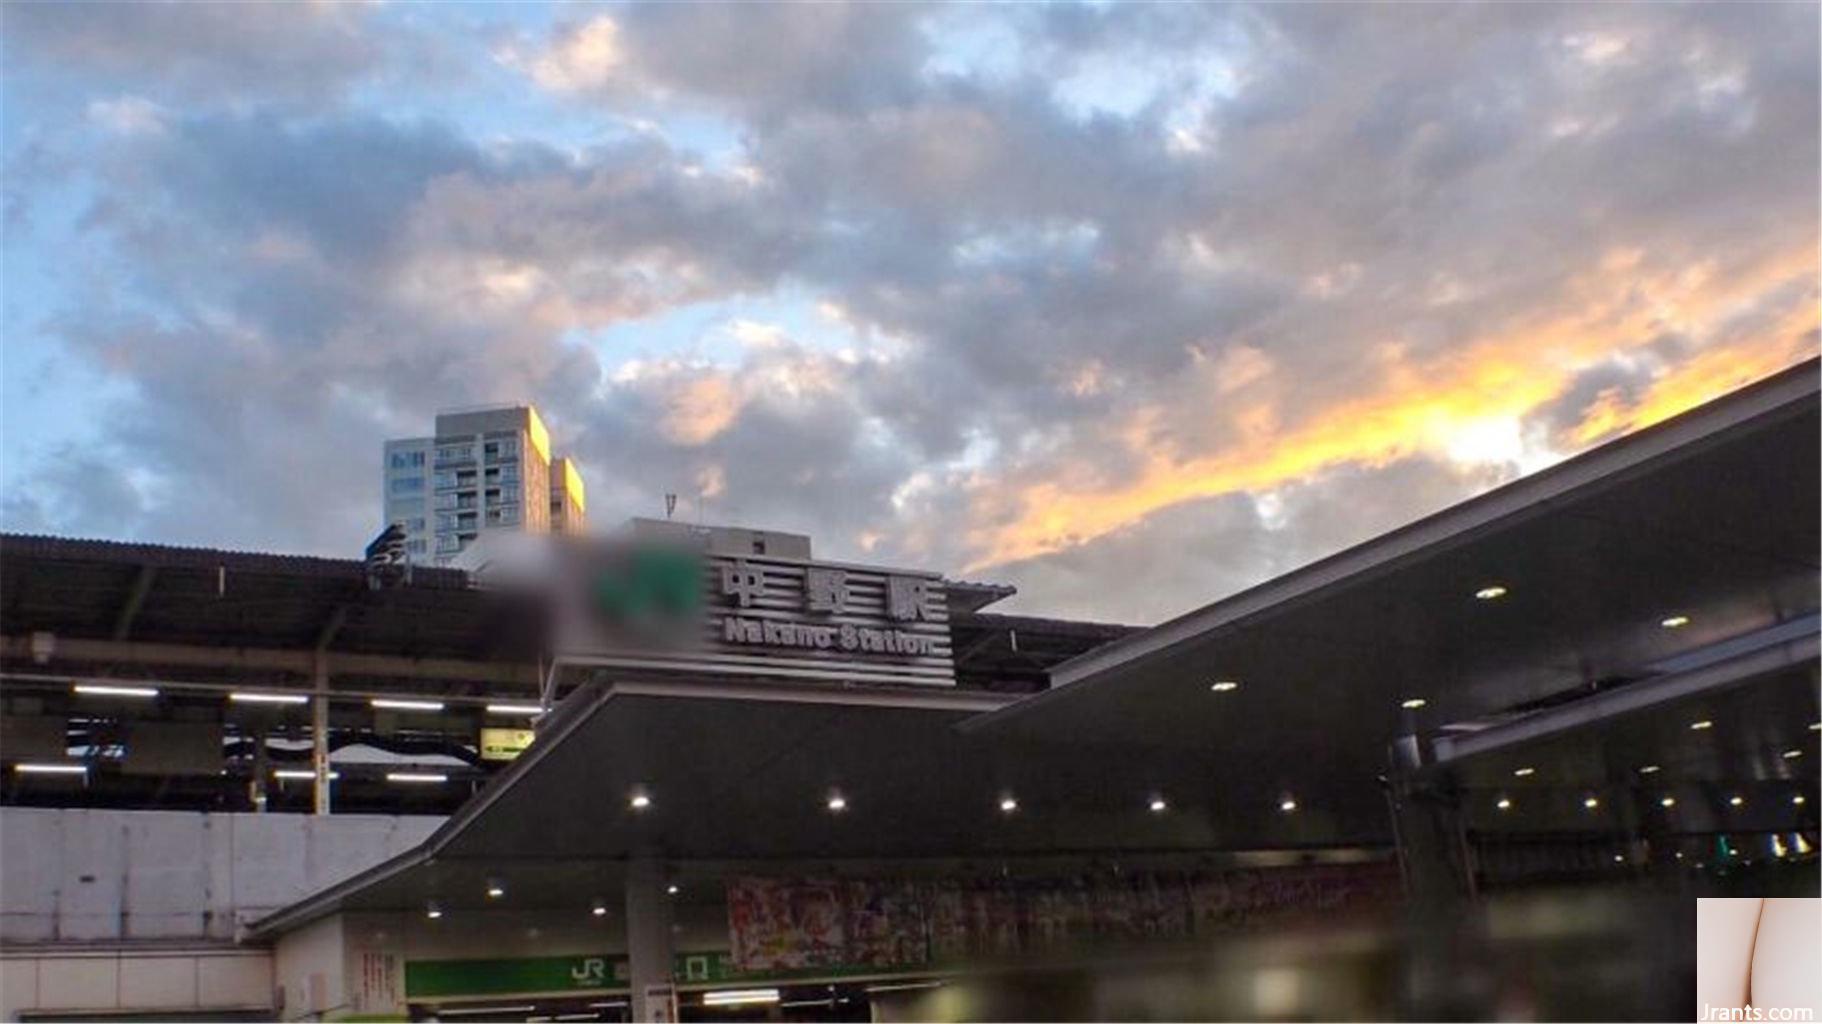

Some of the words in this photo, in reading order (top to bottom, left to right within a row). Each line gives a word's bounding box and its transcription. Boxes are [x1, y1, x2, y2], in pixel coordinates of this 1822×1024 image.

[724, 617, 834, 648] Nakano
[840, 624, 934, 654] Station
[571, 957, 605, 979] JR
